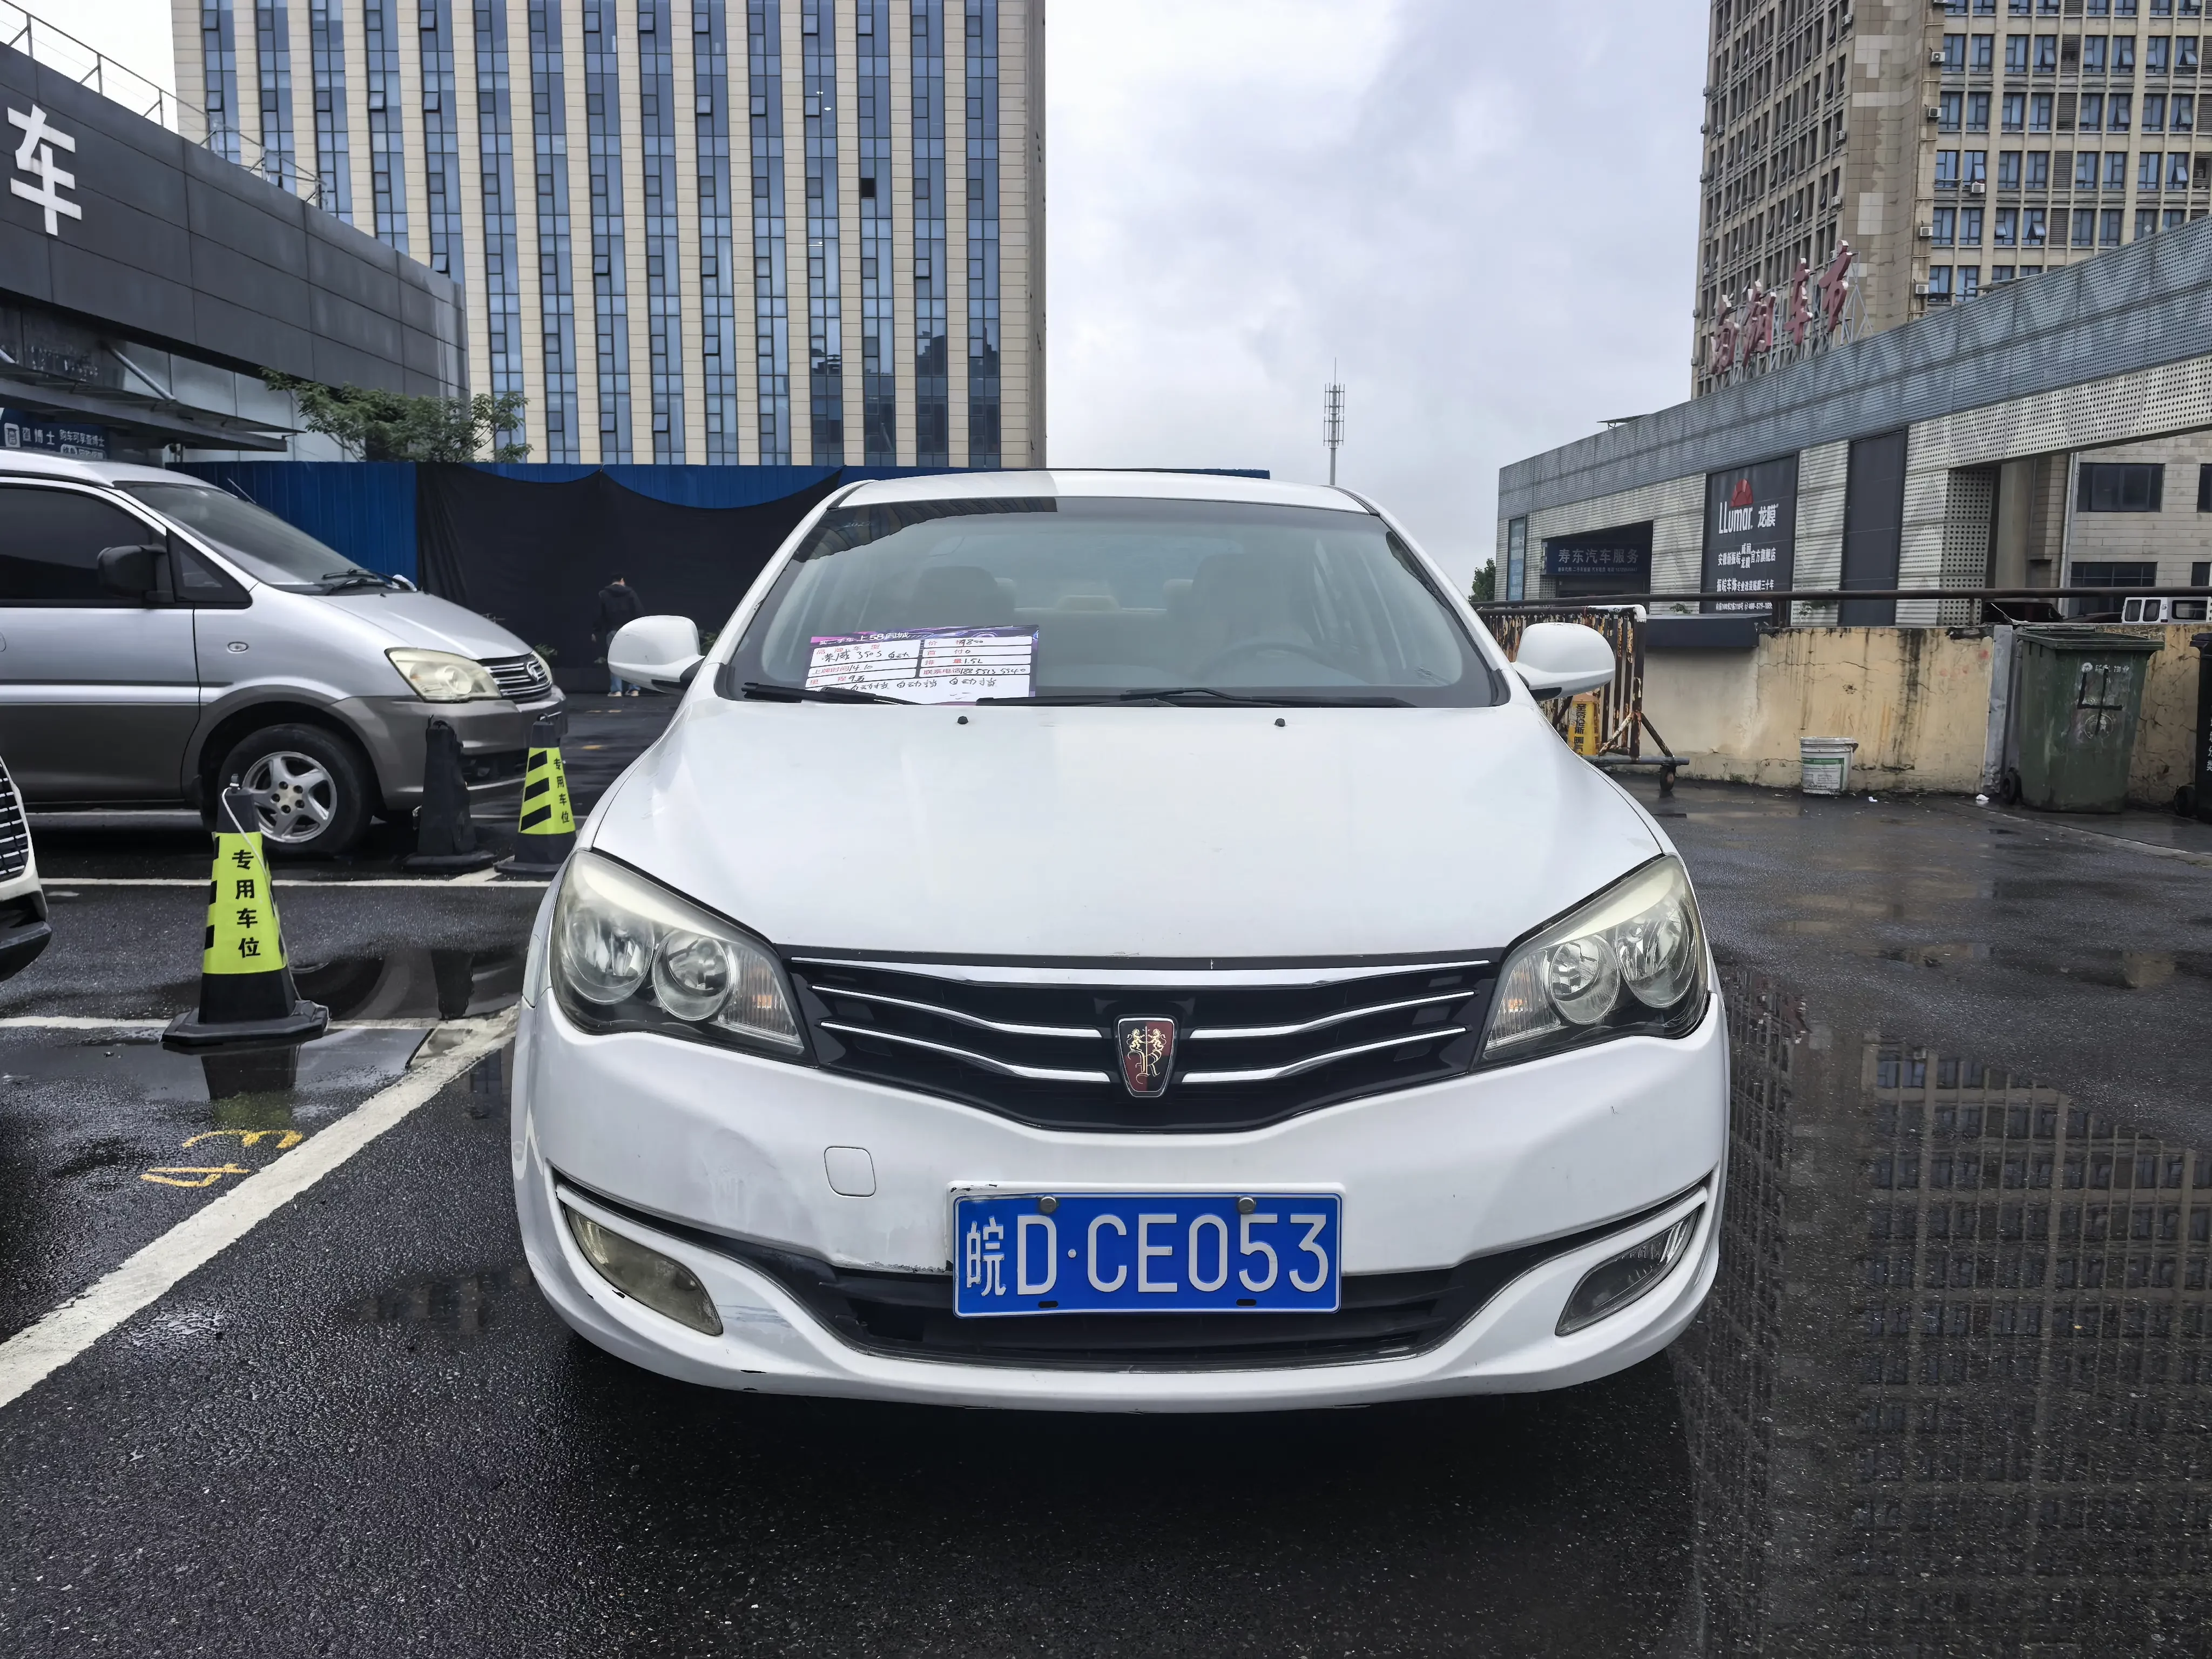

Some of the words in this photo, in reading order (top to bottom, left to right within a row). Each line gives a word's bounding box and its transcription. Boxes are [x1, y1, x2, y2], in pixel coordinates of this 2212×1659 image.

[8, 104, 82, 235] 车
[1719, 501, 1753, 534] LLumar
[1758, 504, 1776, 528] 龙膜
[1558, 548, 1638, 564] 寿东汽车服务
[812, 666, 849, 675] 上牌时间
[554, 758, 570, 824] 专用车位
[232, 849, 261, 958] 专用车位
